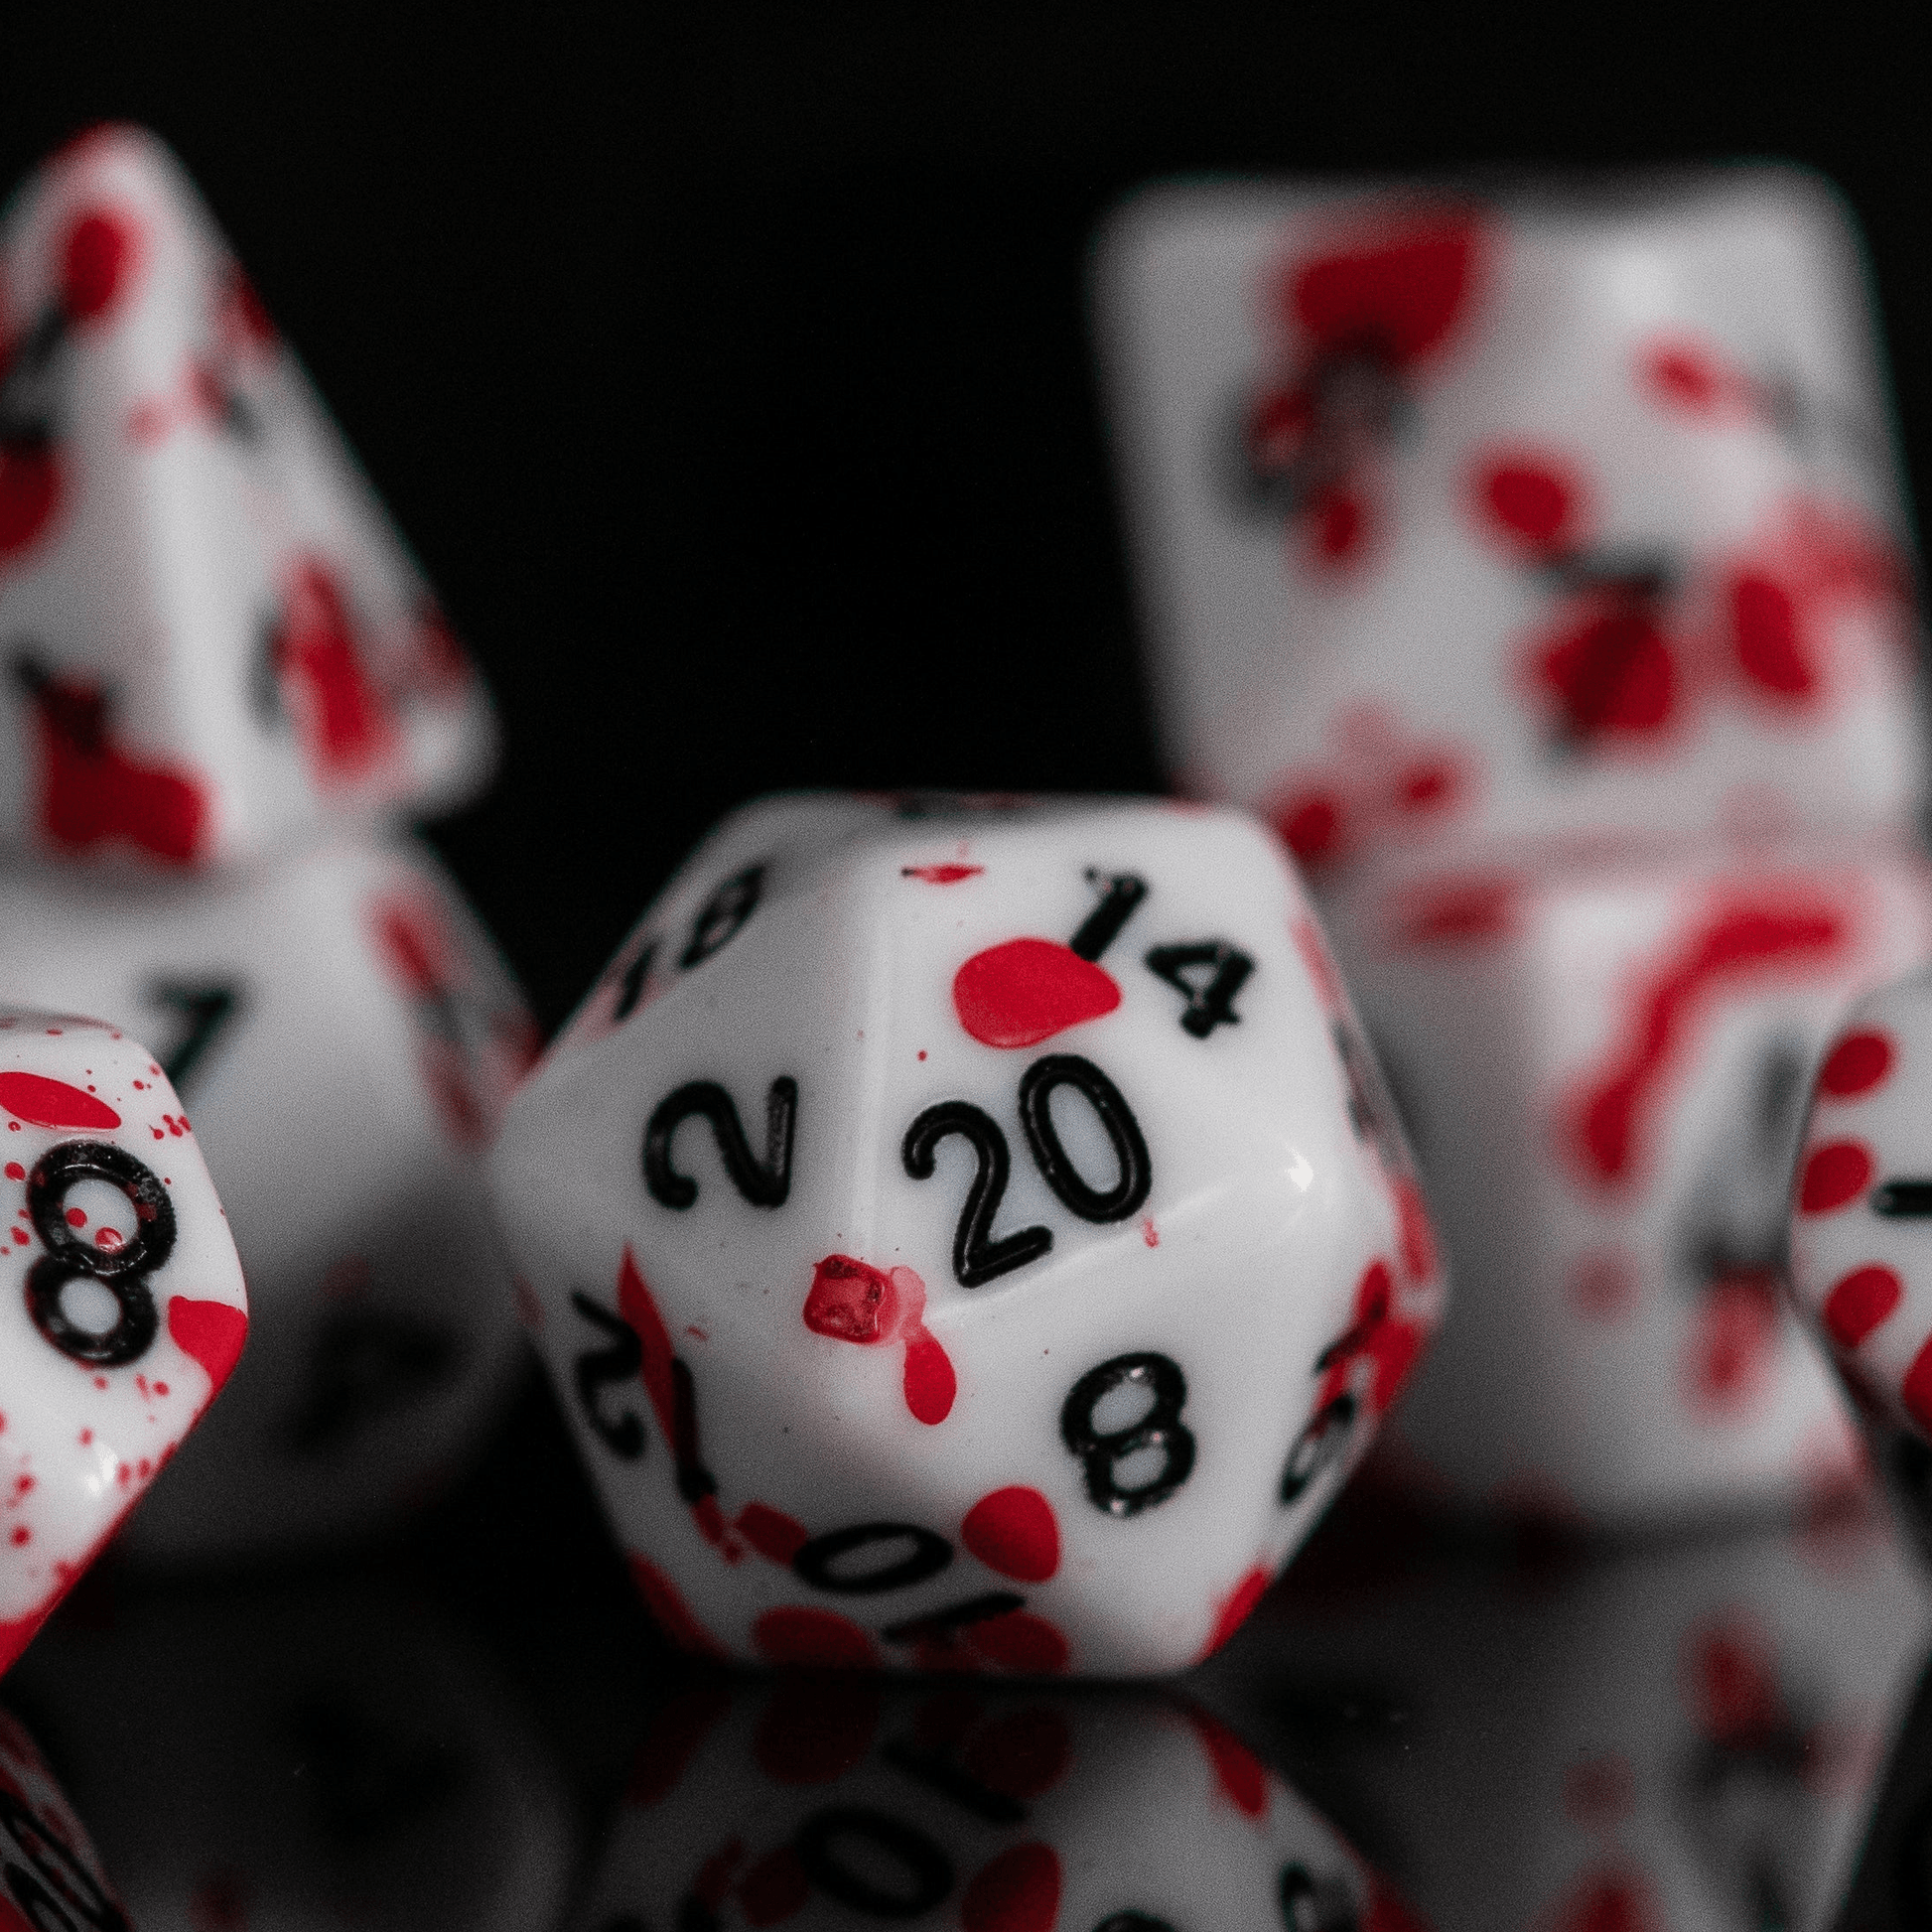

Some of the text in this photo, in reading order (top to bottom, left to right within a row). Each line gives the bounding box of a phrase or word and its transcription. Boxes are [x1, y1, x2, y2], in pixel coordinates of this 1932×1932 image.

[1068, 866, 1255, 1038] 14
[644, 1075, 797, 1211] 2
[902, 1053, 1153, 1288] 20
[27, 1141, 177, 1368] 8
[1061, 1351, 1197, 1517] 8
